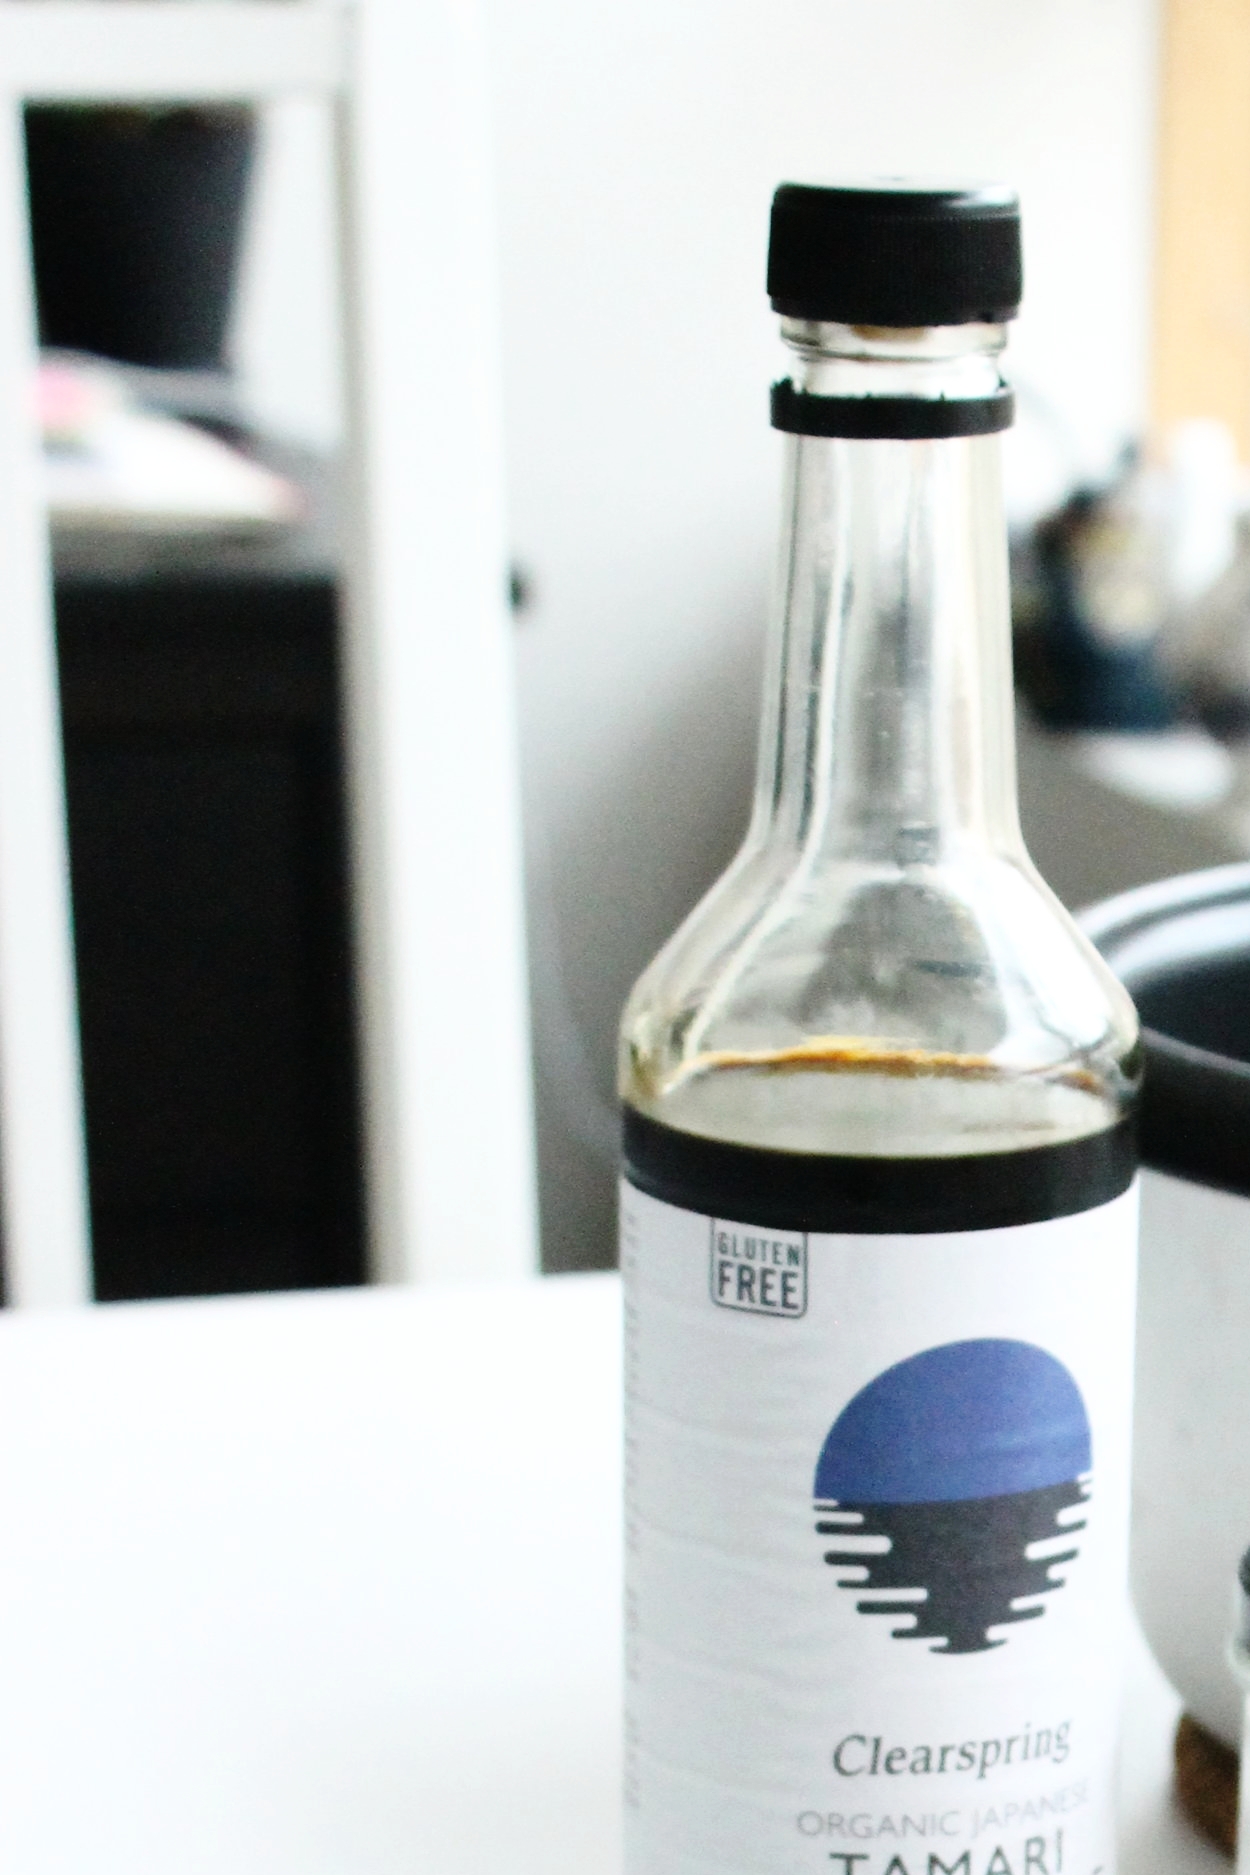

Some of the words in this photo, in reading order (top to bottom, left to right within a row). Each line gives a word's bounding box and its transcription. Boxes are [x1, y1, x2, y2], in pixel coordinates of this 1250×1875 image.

[717, 1231, 800, 1266] GLUTEN
[718, 1260, 799, 1310] FREE
[833, 1719, 1071, 1780] Clearspring
[796, 1809, 961, 1840] ORGANIC
[970, 1778, 1090, 1838] JAPANESE
